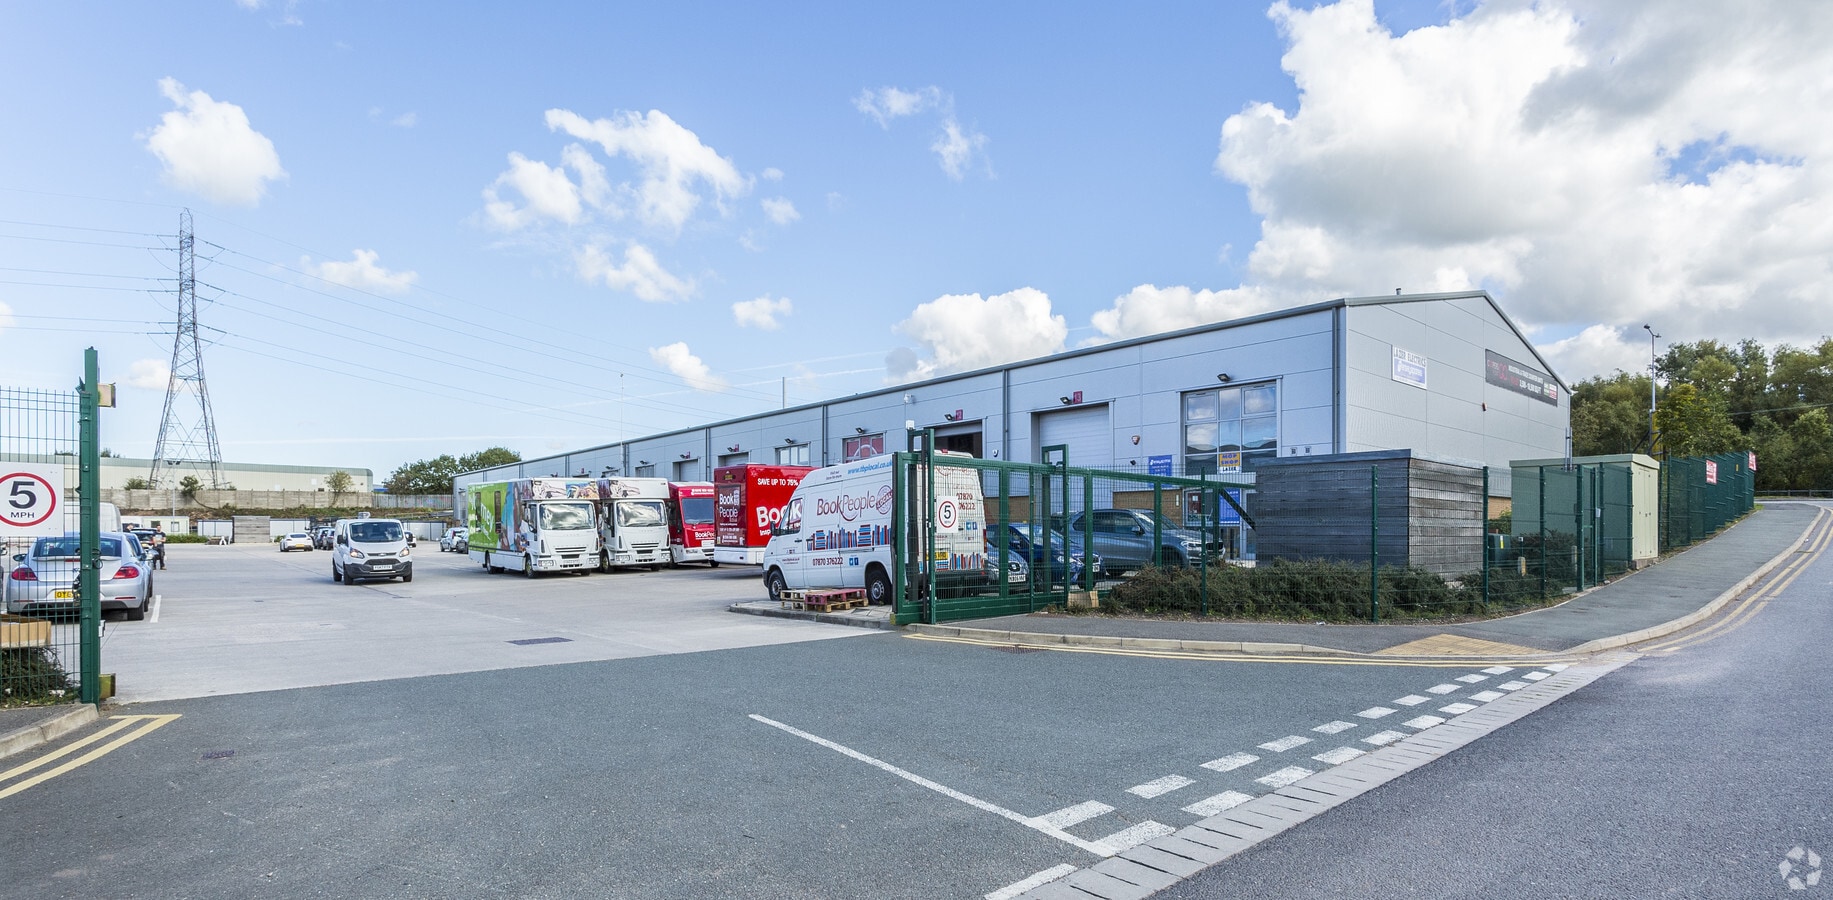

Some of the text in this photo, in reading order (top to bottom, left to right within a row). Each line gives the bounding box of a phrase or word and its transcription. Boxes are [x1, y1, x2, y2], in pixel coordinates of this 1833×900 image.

[757, 478, 770, 486] SAVE
[771, 478, 778, 486] UP
[787, 479, 799, 487] 75%
[8, 480, 37, 509] 5
[719, 493, 734, 505] Book
[958, 502, 975, 510] 76222
[10, 511, 35, 519] MPH
[719, 506, 738, 518] People
[943, 504, 951, 520] 5
[812, 557, 843, 566] 07870 376222
